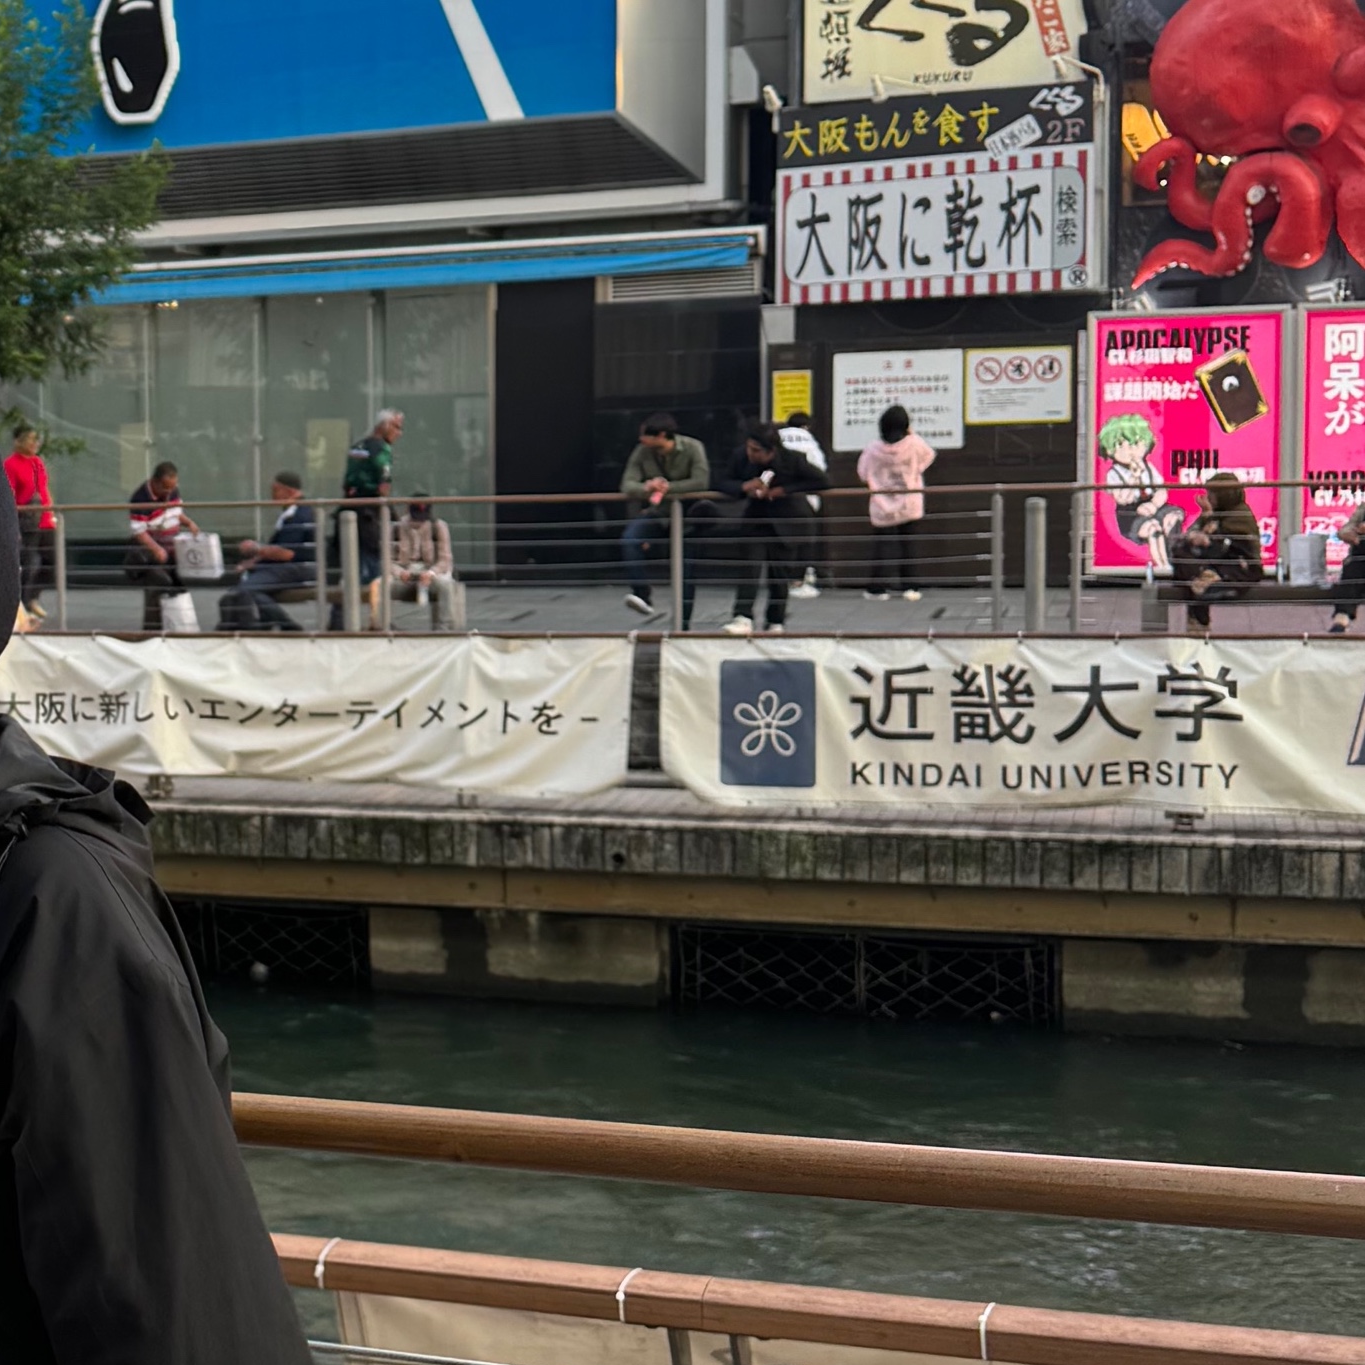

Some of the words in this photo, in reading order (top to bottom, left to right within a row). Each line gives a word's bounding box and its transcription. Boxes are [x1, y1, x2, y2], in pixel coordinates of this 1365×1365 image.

[819, 0, 854, 82] 頓堀
[912, 70, 974, 84] KUKURU
[783, 101, 1000, 159] 大阪もんを食す
[1046, 117, 1085, 144] 2F
[795, 175, 1044, 279] 大阪に乾杯
[1055, 184, 1078, 247] 検索
[1104, 325, 1251, 357] APOCALYPSE
[849, 661, 1244, 746] 近畿大学
[850, 760, 982, 788] KINDAI
[1001, 761, 1240, 790] UNIVERSITY
